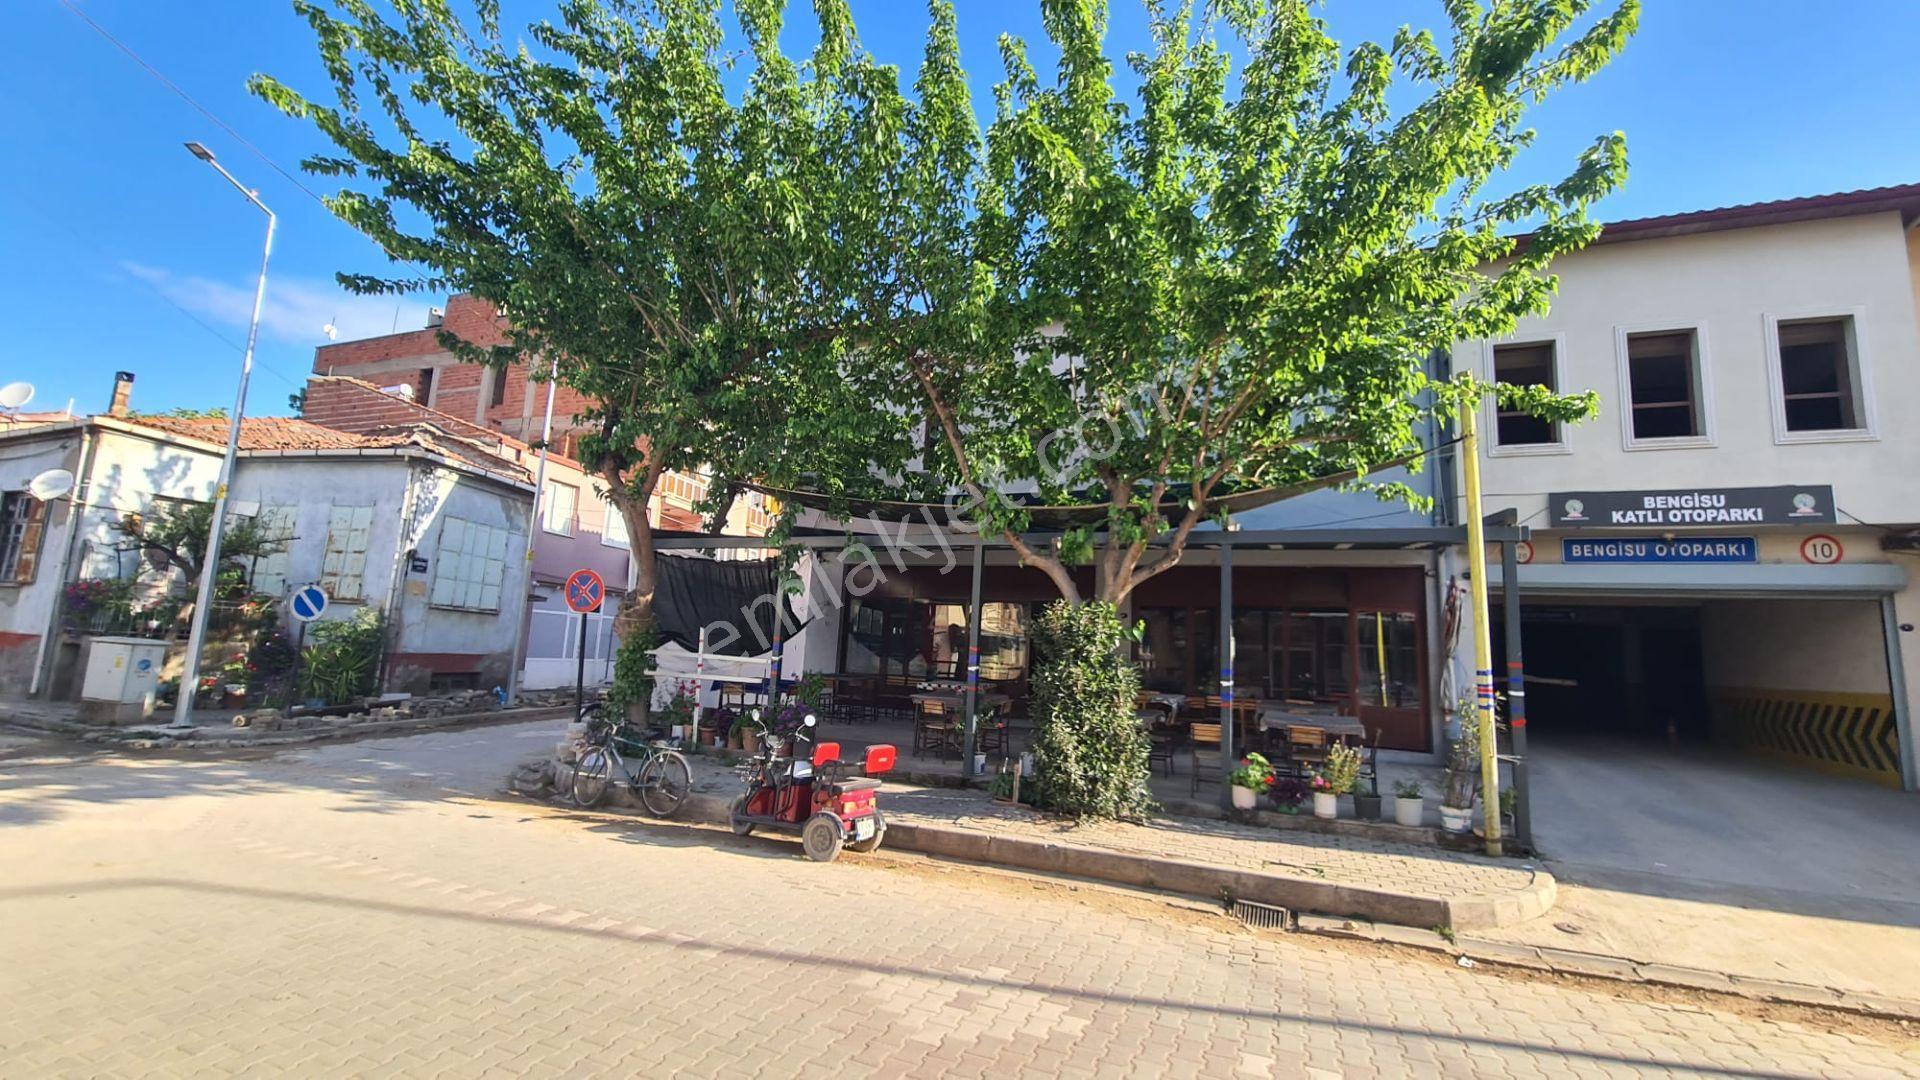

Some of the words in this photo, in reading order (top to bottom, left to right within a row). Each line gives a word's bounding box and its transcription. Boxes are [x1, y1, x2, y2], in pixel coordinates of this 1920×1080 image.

[1643, 493, 1726, 509] BENGİSU
[1611, 510, 1663, 523] KATLI
[1668, 508, 1763, 522] OTOPARKI
[1572, 542, 1646, 556] BENGİSU
[1655, 544, 1746, 556] OTOPARKI
[1812, 543, 1833, 559] 10
